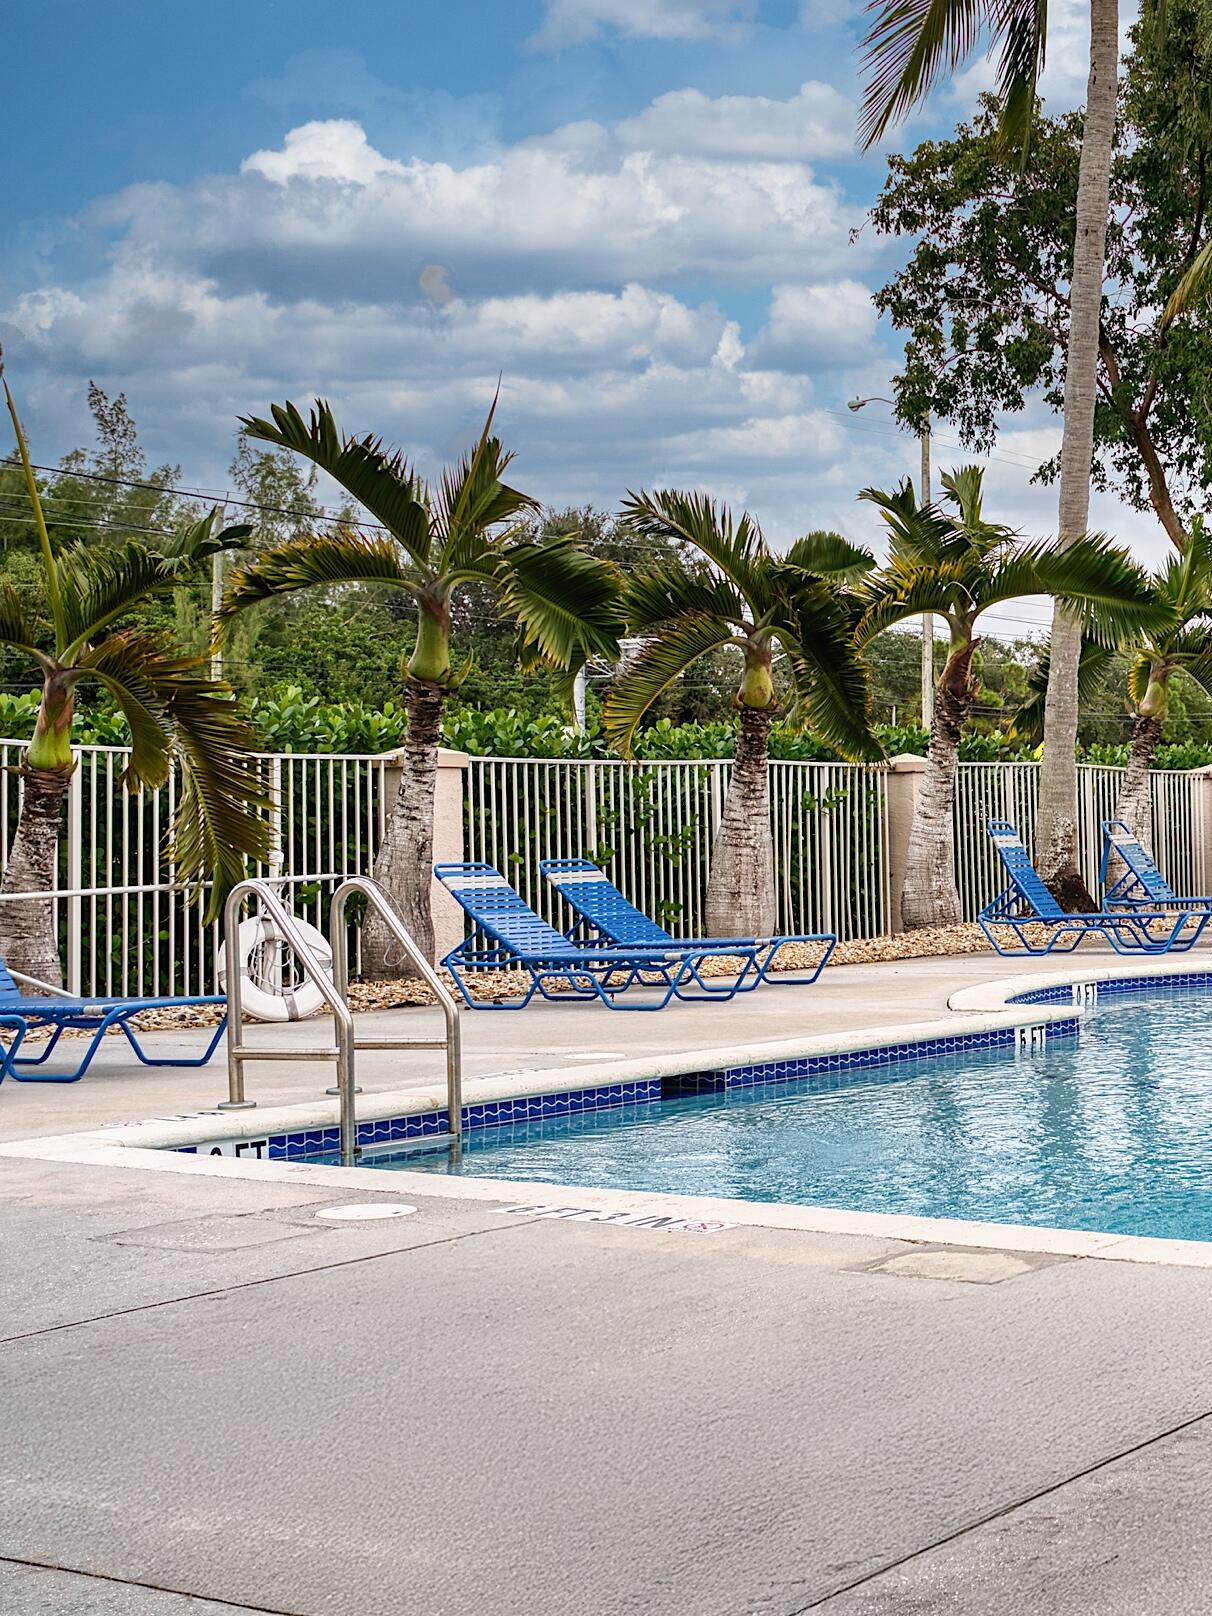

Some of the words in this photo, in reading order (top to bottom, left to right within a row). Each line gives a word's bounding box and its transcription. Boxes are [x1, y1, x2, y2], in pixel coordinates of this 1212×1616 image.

[507, 1205, 546, 1213] 6
[535, 1207, 600, 1219] FT
[591, 1212, 631, 1222] 3
[624, 1215, 685, 1228] IN
